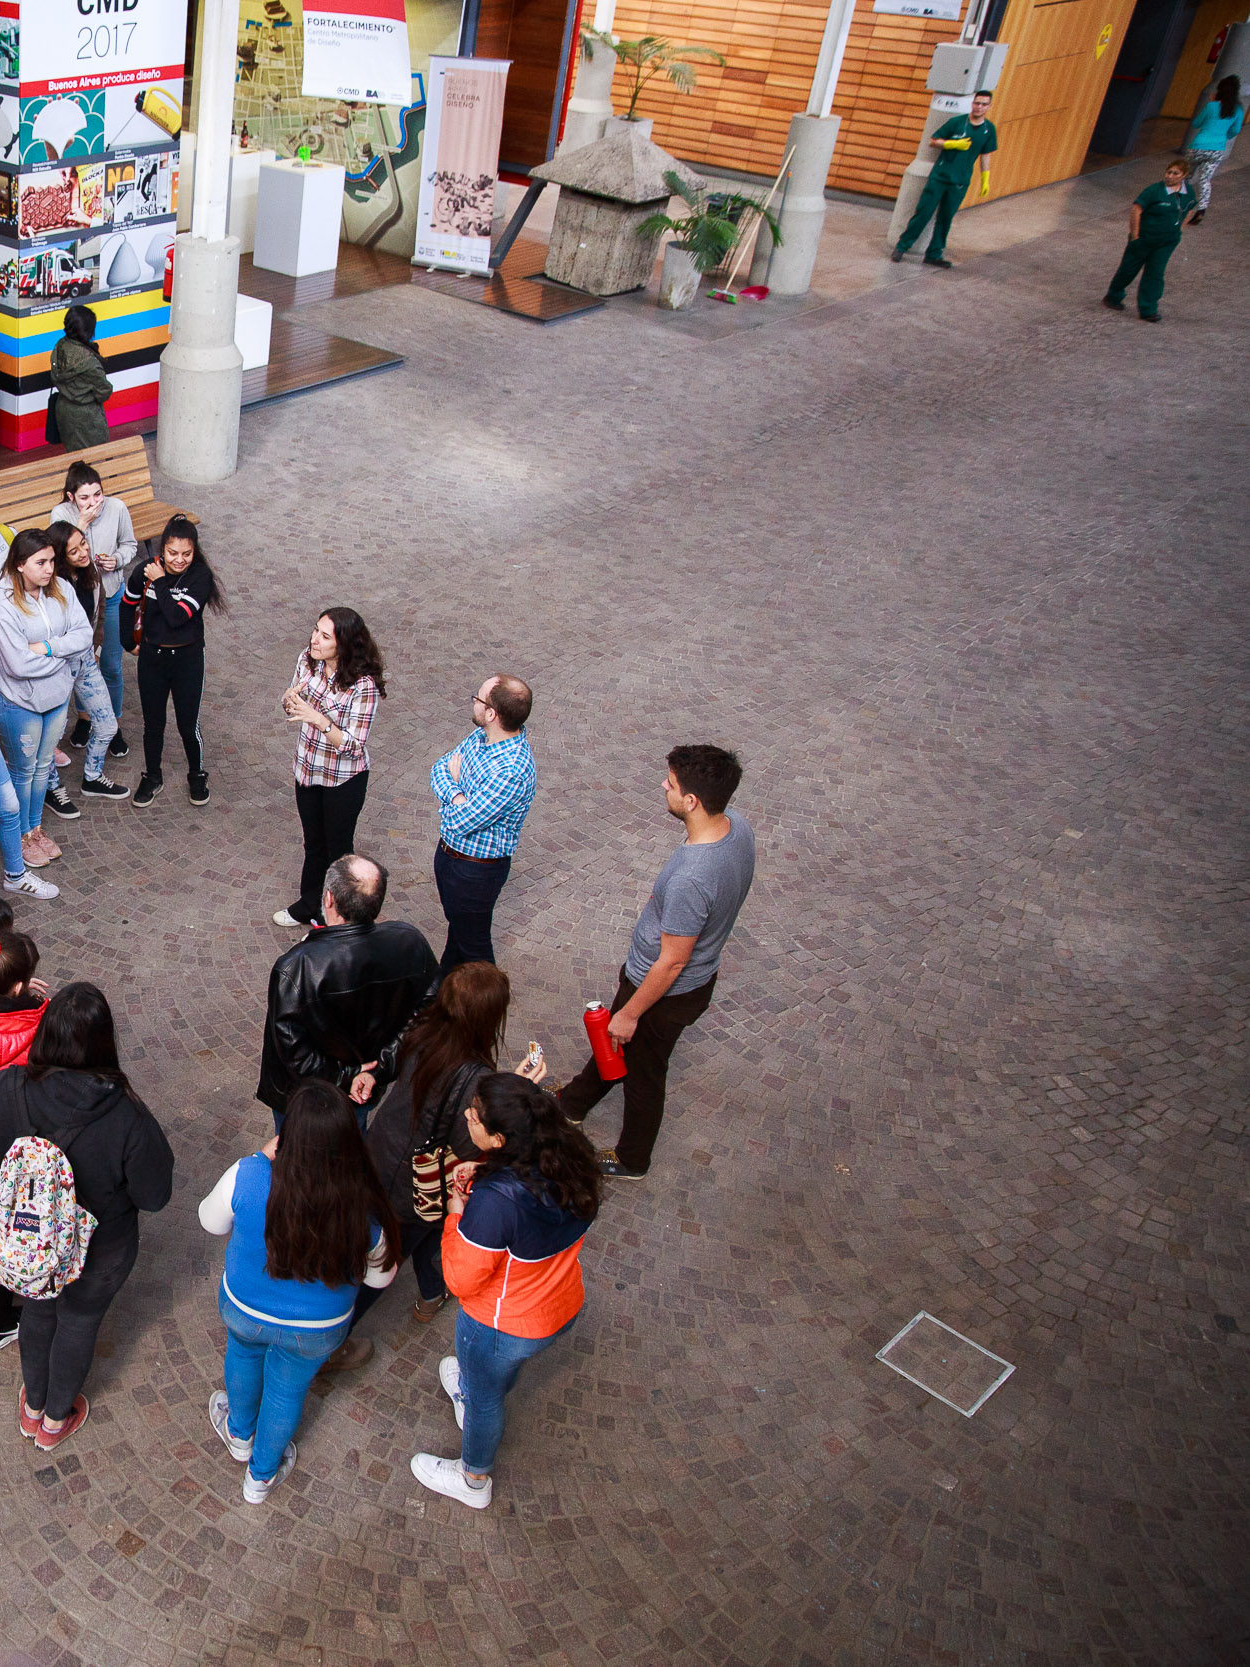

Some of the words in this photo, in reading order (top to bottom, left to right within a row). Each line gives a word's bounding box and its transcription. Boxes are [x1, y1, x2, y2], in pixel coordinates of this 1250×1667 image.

[307, 18, 394, 34] FORTALECIMIENTO
[76, 22, 138, 60] 2017
[307, 29, 331, 38] Centro
[331, 30, 379, 43] Metropolitano
[48, 80, 78, 92] Buenos
[79, 77, 101, 88] Aires
[102, 72, 135, 87] produce
[136, 69, 161, 81] diseño
